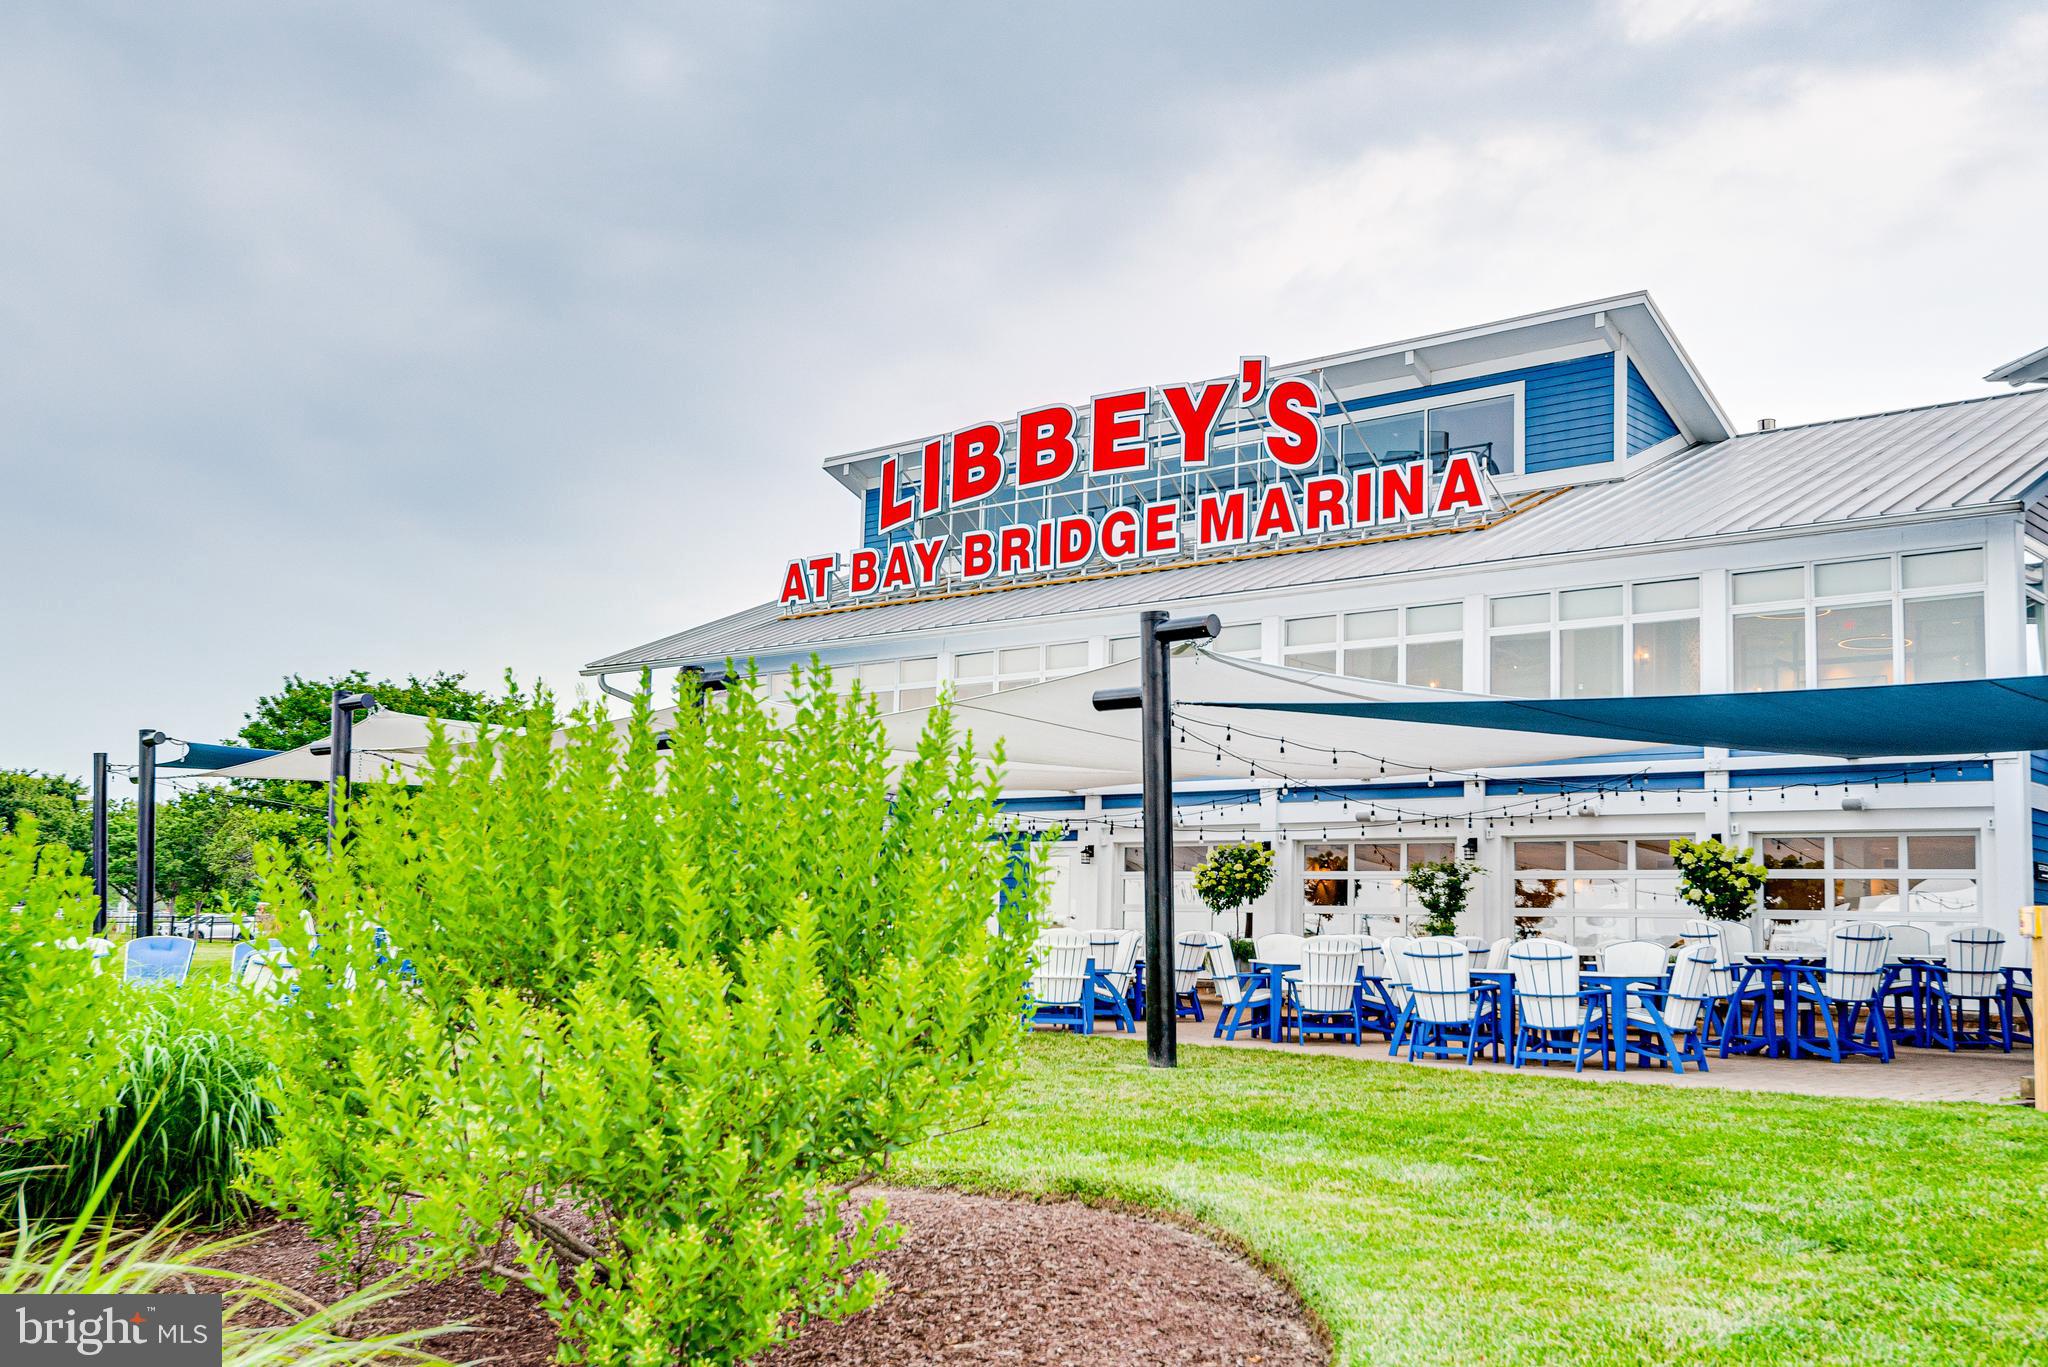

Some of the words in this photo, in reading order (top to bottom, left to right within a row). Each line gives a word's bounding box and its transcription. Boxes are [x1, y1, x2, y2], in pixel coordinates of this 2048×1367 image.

[878, 355, 1322, 535] LIBBEY'S
[778, 553, 837, 606] AT
[849, 535, 950, 596] BAY
[961, 500, 1180, 581] BRIDGE
[1197, 452, 1492, 549] MARINA
